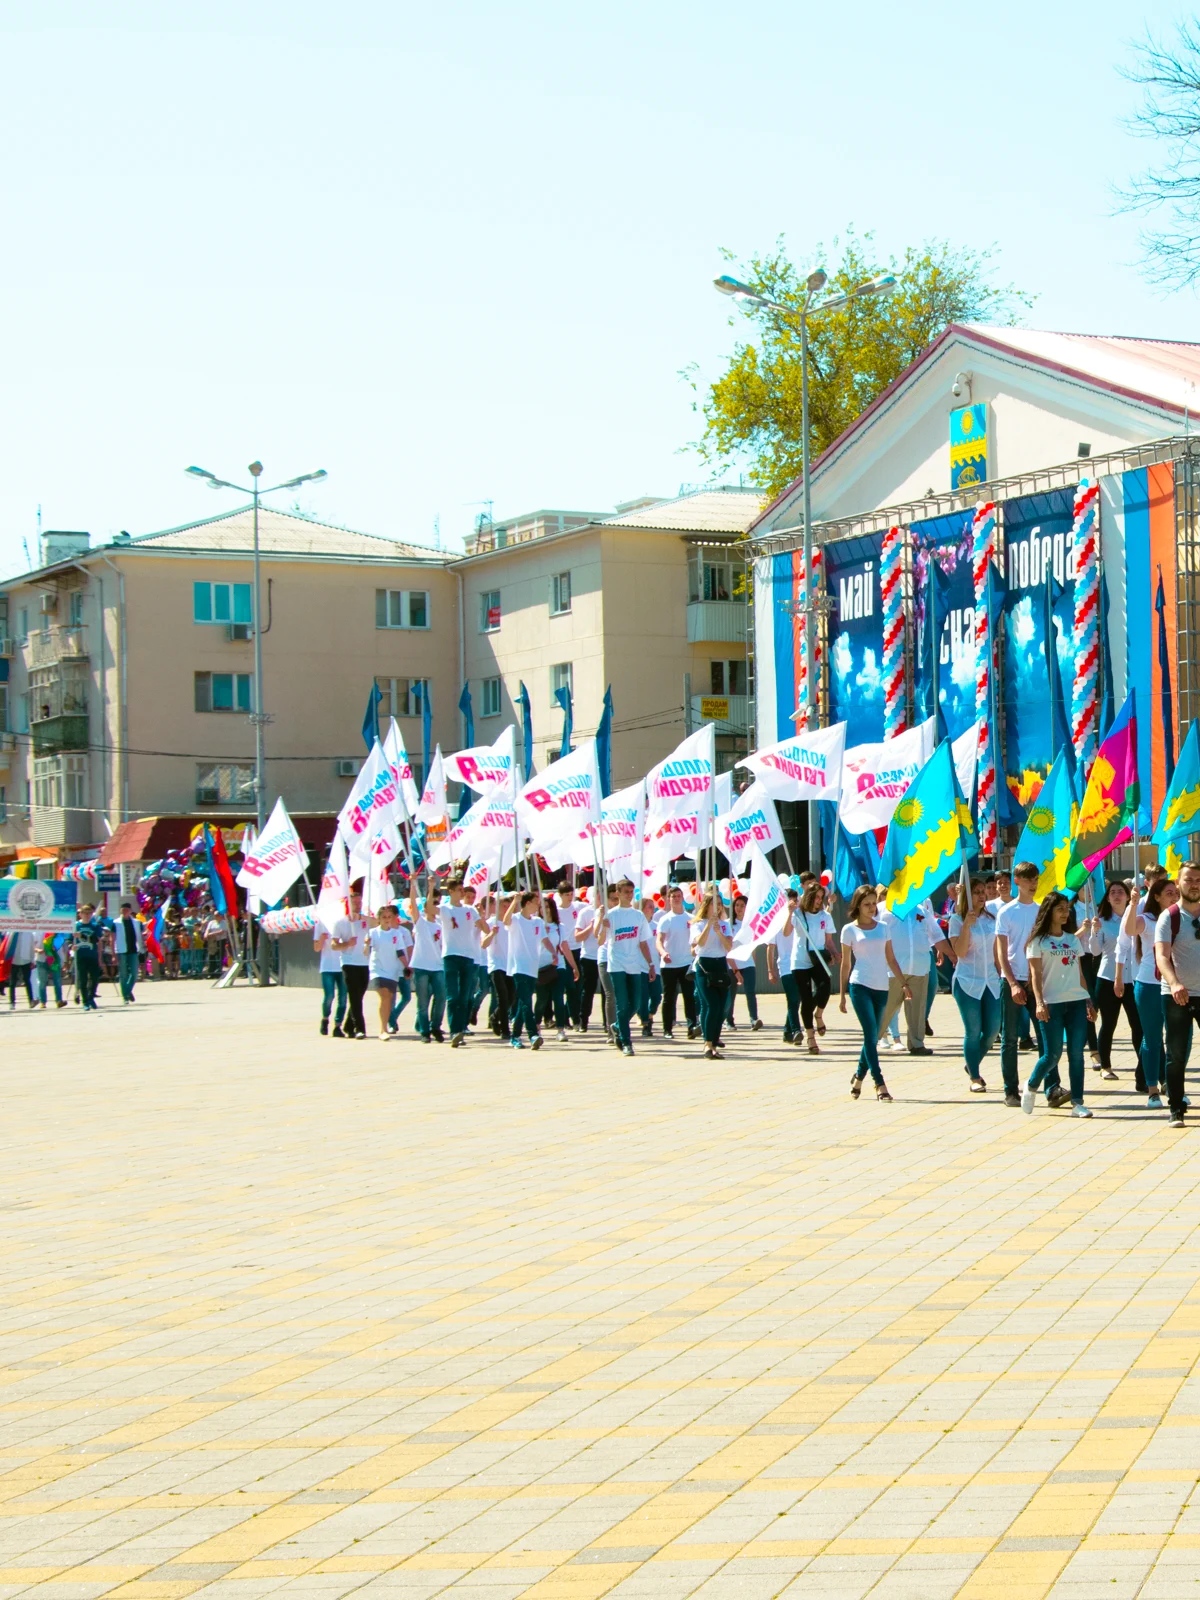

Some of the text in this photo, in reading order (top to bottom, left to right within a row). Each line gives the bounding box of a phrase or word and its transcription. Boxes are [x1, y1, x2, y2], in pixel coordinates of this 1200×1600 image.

[1009, 526, 1077, 591] победа
[840, 561, 873, 622] май
[918, 607, 976, 669] сна
